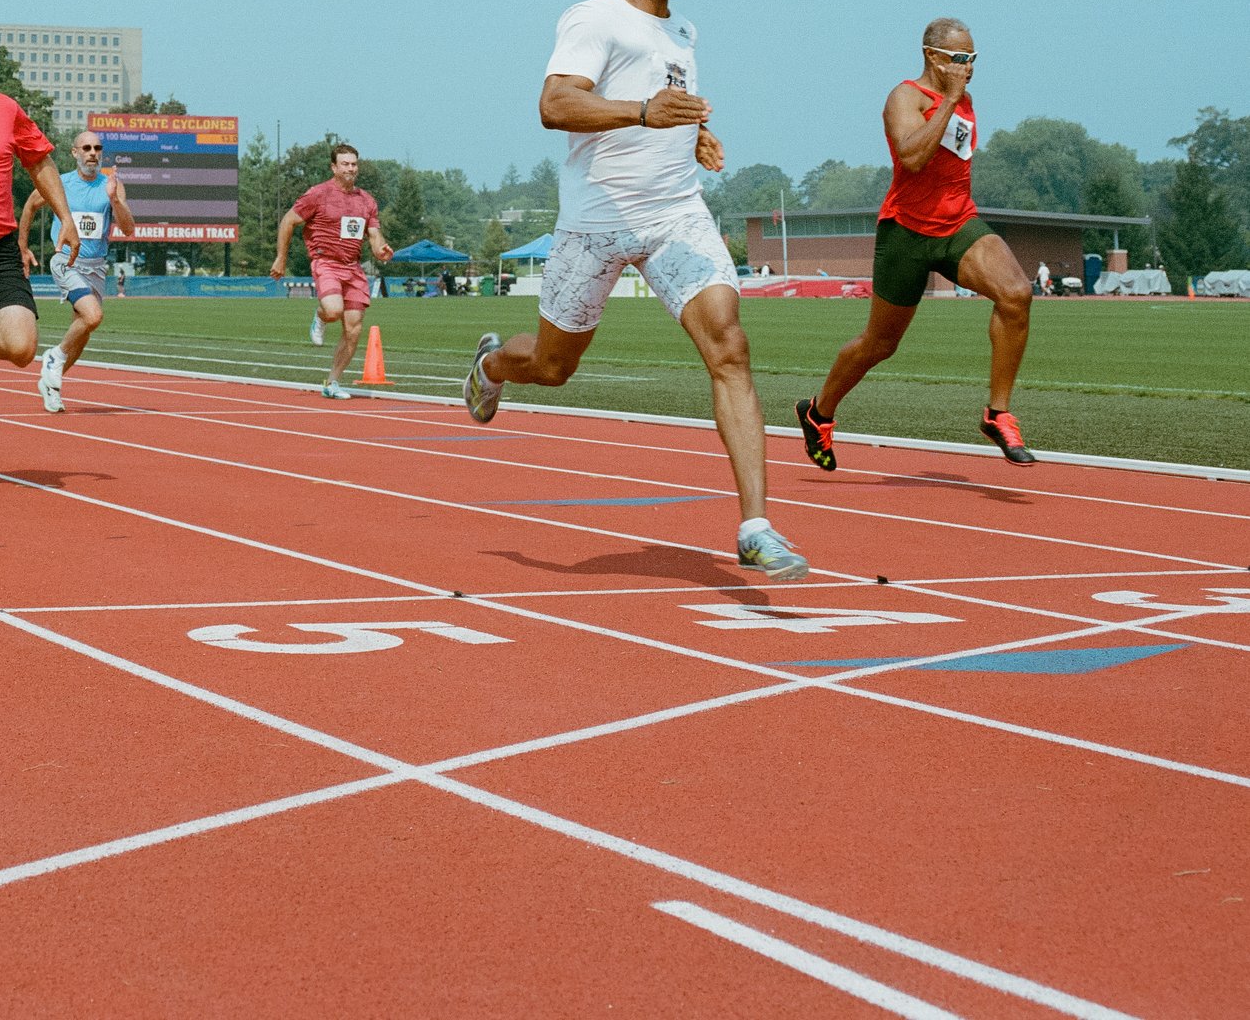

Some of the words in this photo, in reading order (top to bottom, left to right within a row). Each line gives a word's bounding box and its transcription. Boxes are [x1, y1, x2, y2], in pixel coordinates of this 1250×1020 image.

[92, 117, 125, 128] IOWA
[129, 118, 168, 129] STATE
[172, 118, 235, 130] CYCLONES
[106, 132, 119, 141] 100
[120, 133, 139, 141] Meter
[140, 133, 158, 142] Dash
[134, 226, 165, 238] KAREN
[167, 227, 204, 239] BERGAN
[206, 227, 236, 239] TRACK
[677, 603, 966, 633] 4
[187, 621, 516, 654] 5
